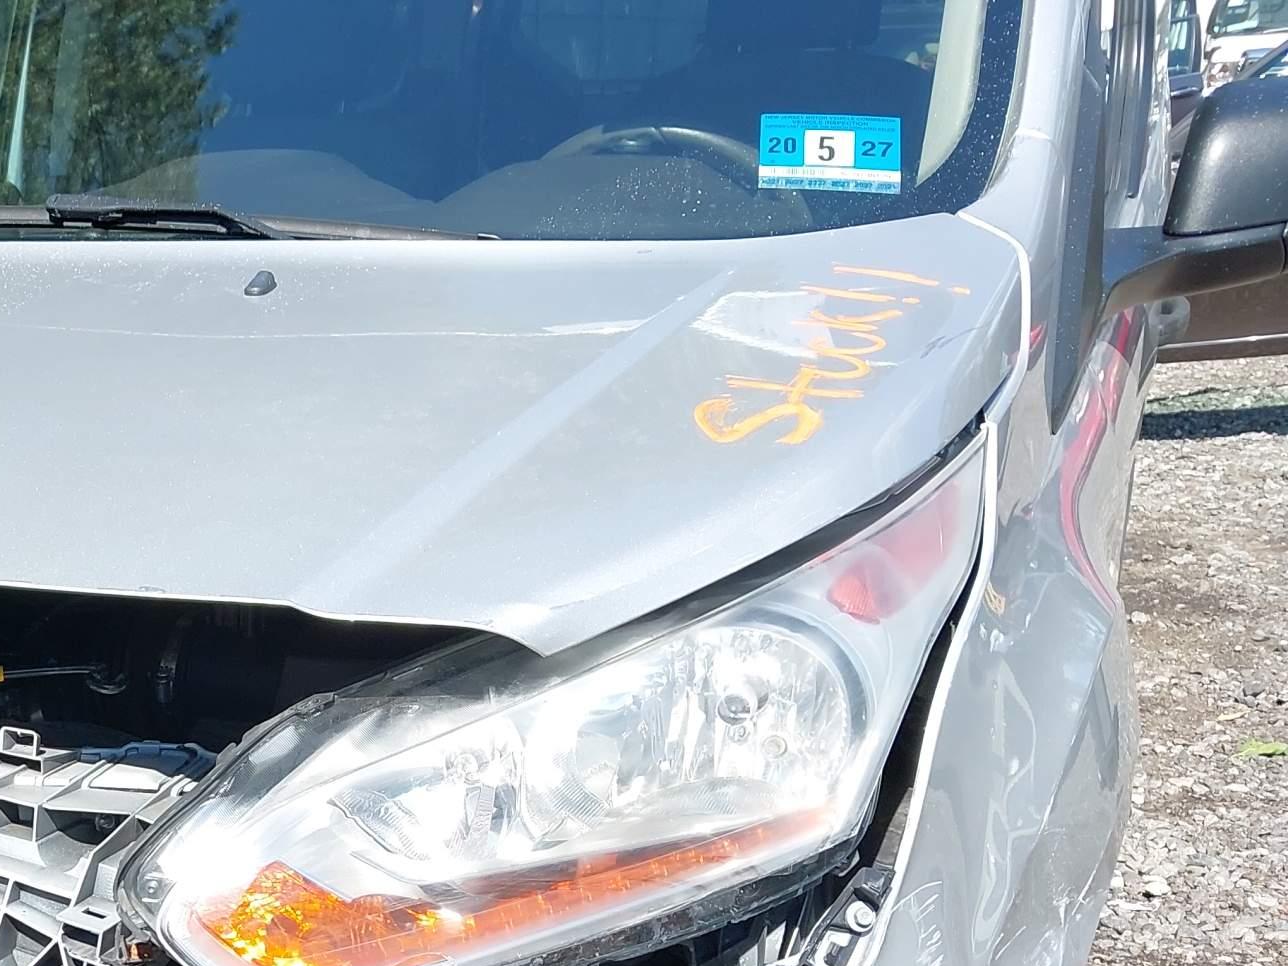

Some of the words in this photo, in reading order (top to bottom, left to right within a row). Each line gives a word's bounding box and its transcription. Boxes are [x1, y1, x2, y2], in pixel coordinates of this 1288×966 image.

[768, 137, 797, 154] 20
[818, 136, 835, 162] 5
[861, 141, 894, 158] 27
